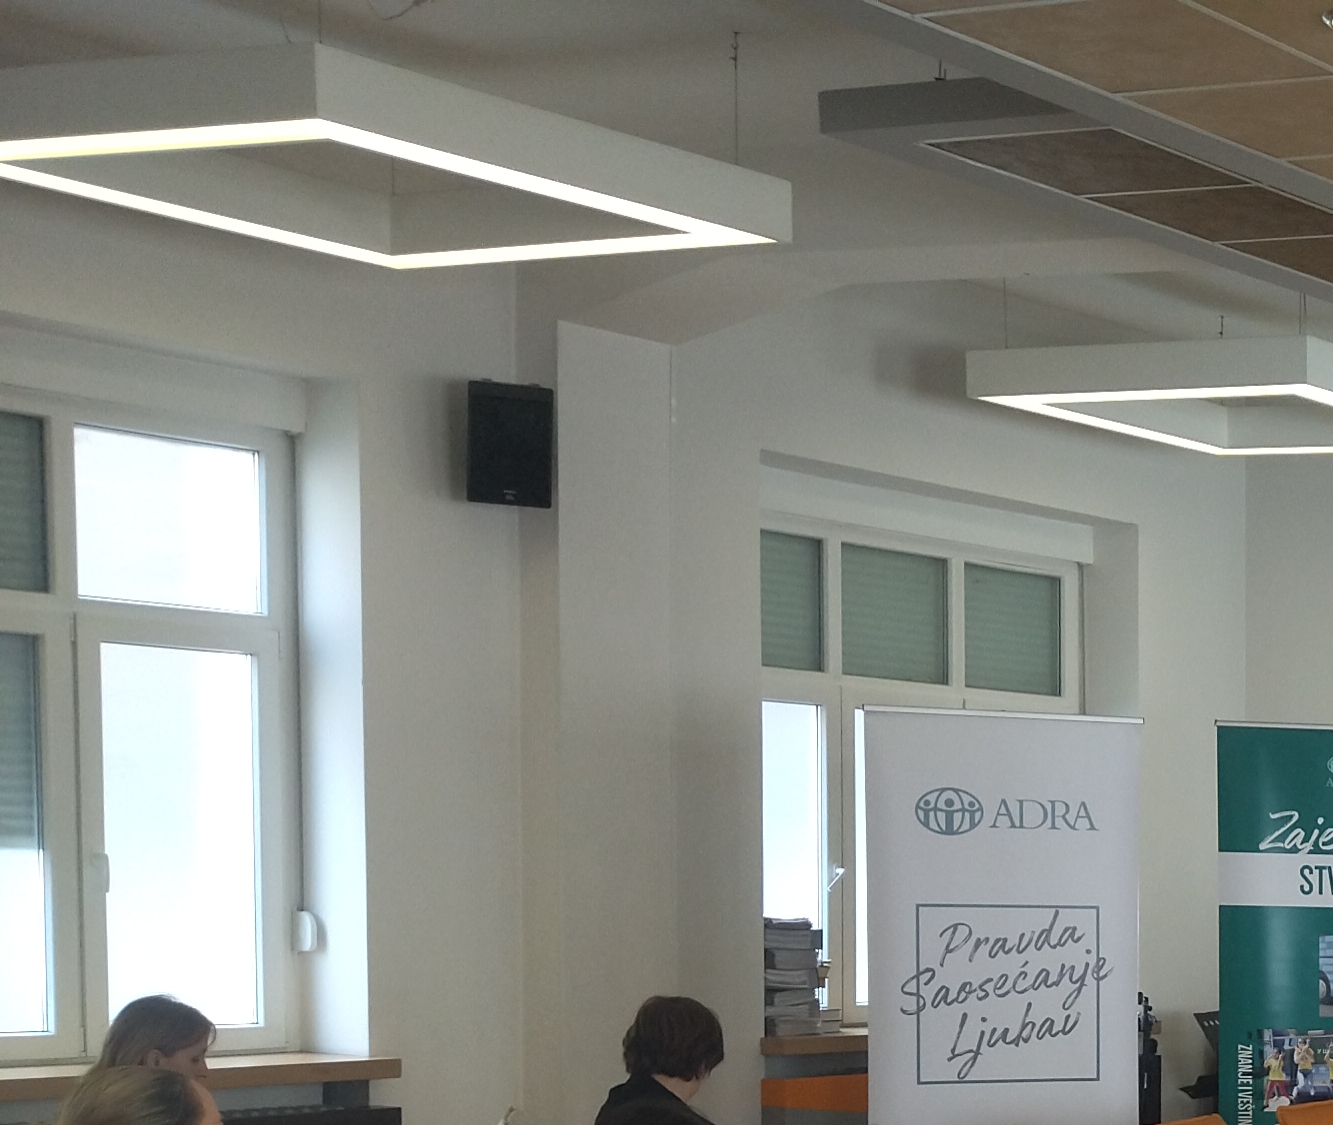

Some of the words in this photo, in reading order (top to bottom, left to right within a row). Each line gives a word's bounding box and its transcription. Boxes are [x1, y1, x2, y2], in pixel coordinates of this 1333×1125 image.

[989, 797, 1099, 832] ADRA
[938, 909, 1086, 968] Pravda
[900, 947, 1115, 1016] Saosećanje
[946, 1003, 1082, 1080] Ljubav
[1237, 1044, 1253, 1085] ZNANJE
